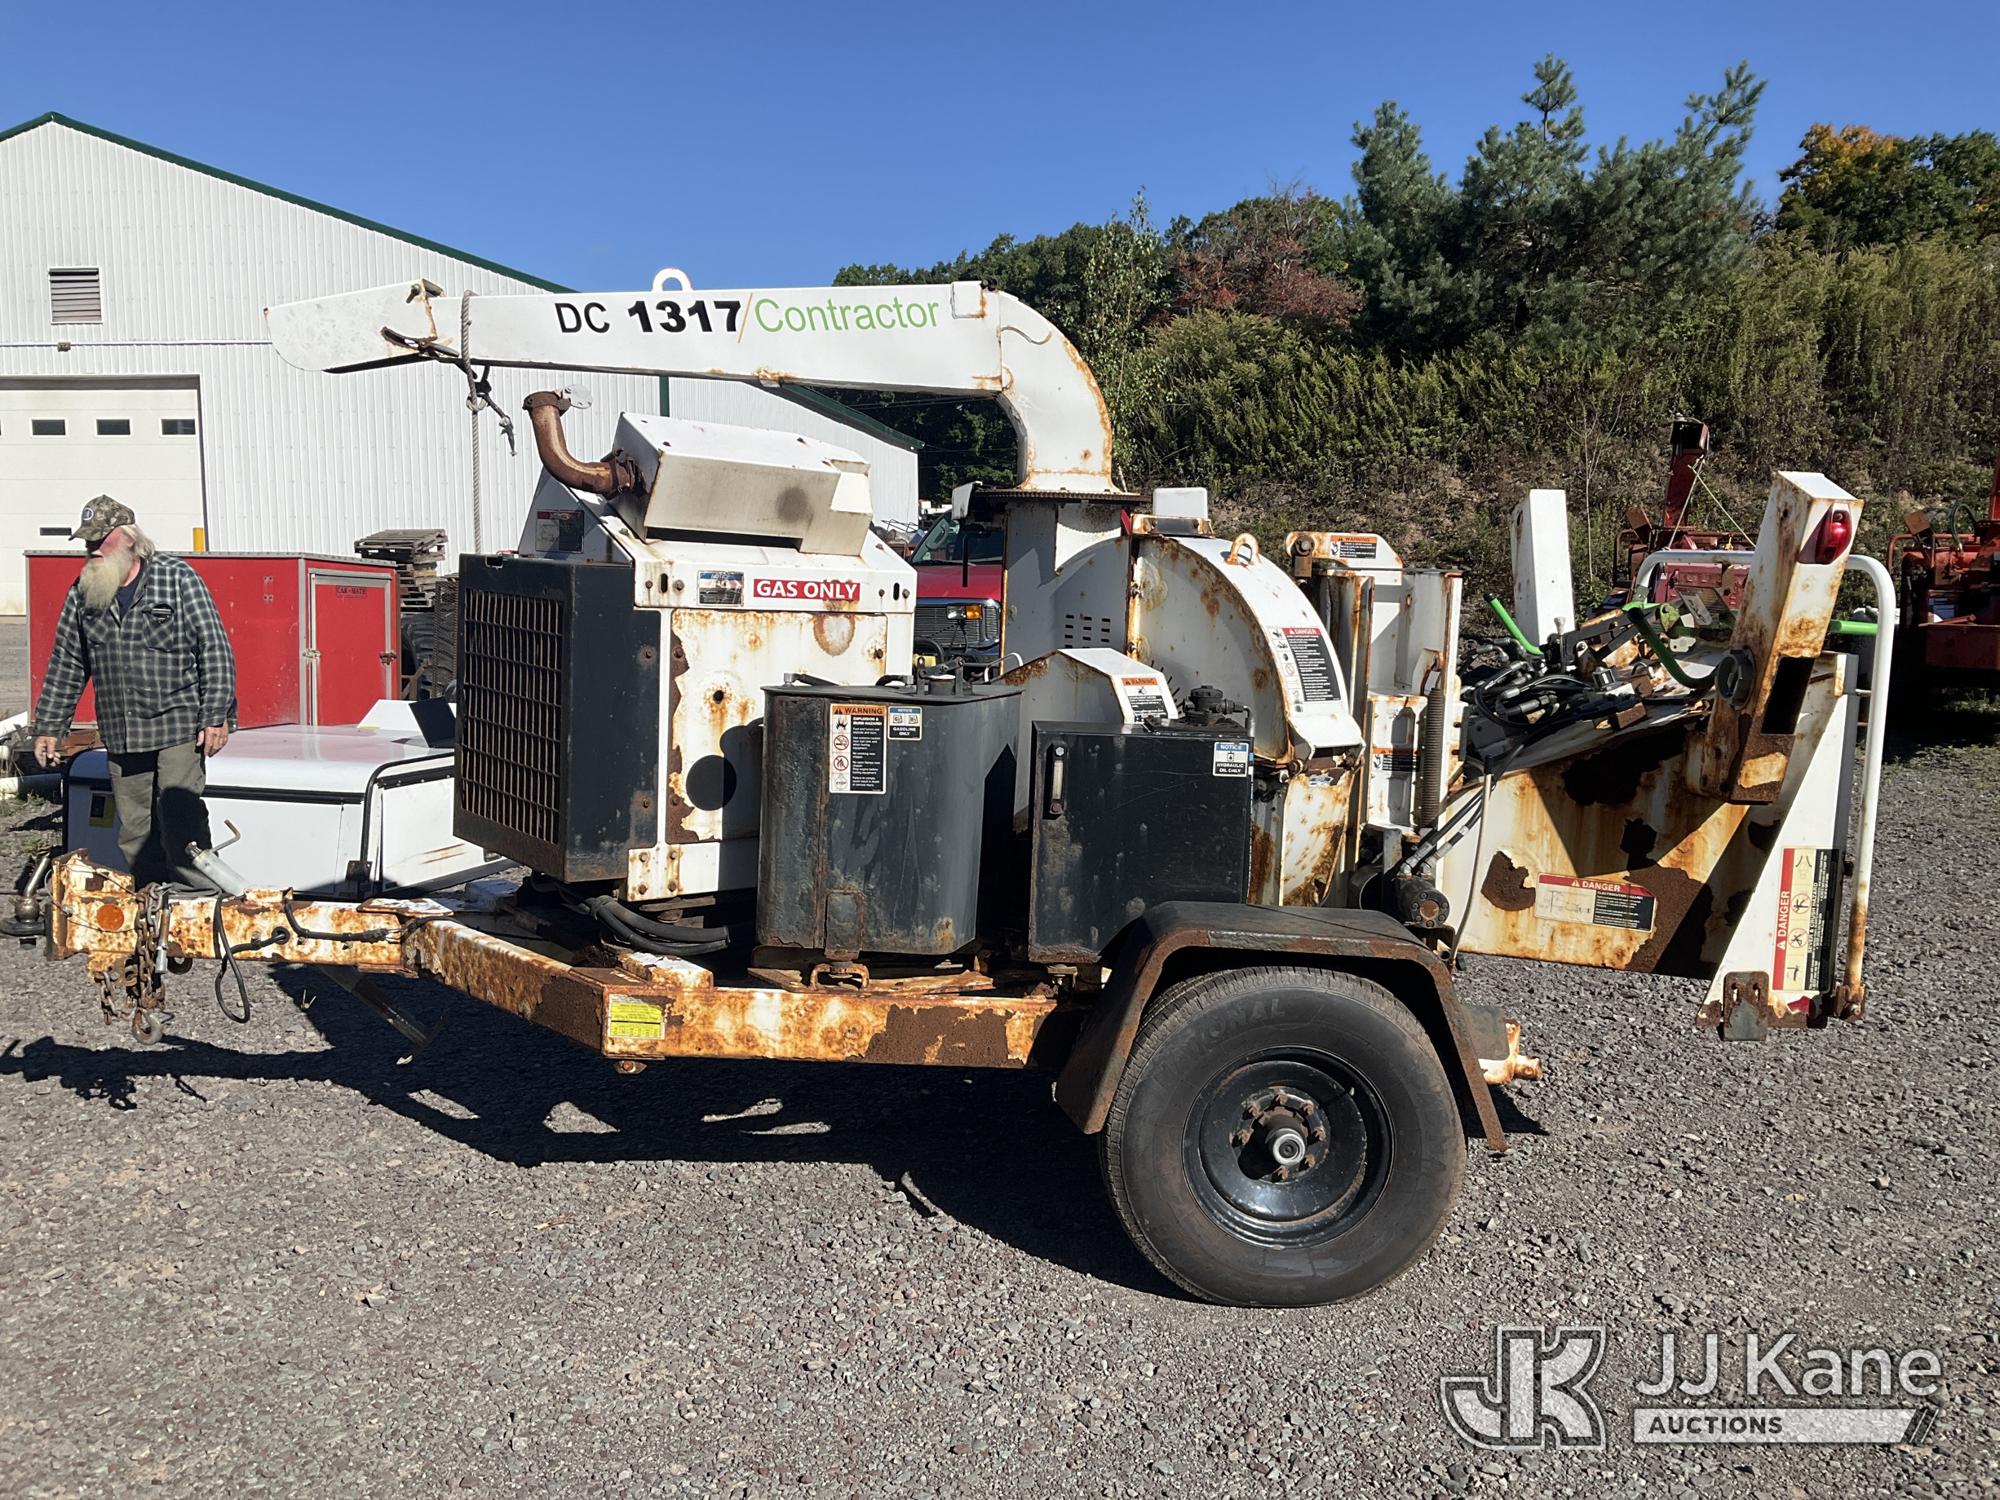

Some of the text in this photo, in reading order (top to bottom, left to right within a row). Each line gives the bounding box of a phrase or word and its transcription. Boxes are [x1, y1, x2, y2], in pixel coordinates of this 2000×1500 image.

[554, 296, 940, 334] DC 1317 Contractor
[756, 580, 798, 597] GAS
[803, 583, 858, 599] ONLY
[844, 707, 883, 715] WARNING
[1581, 880, 1621, 893] DANGER
[1778, 890, 1790, 937] DANGER
